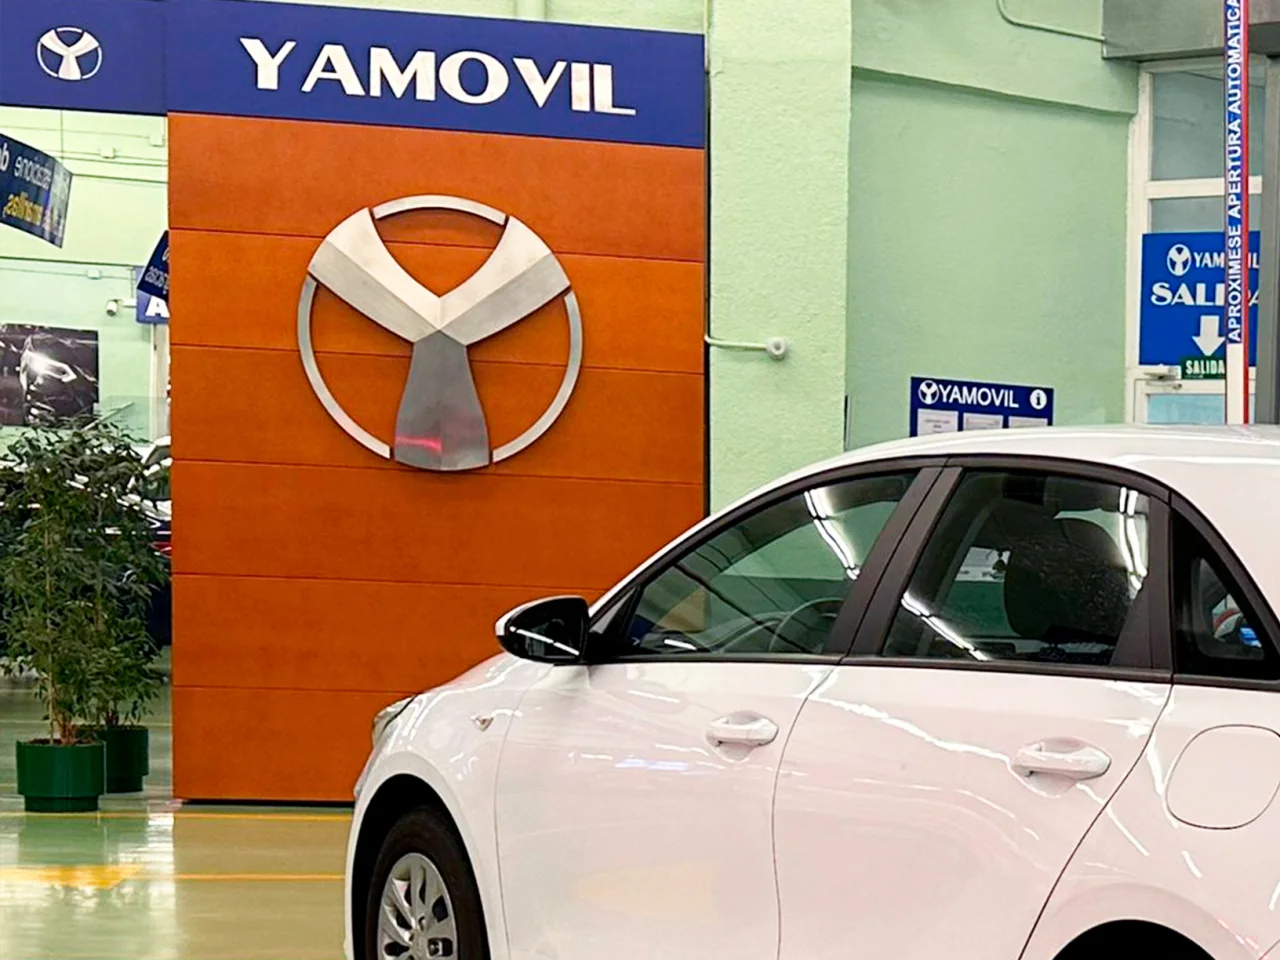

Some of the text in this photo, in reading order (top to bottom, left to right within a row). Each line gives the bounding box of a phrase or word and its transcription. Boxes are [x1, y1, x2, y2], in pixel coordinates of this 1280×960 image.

[240, 38, 636, 115] YAMOVIL
[1228, 119, 1242, 219] APERTURA
[1193, 252, 1259, 268] YAMIL
[1228, 224, 1242, 342] APROXIMESE
[1185, 360, 1226, 374] SALIDA
[939, 384, 1019, 408] YAMOVIL
